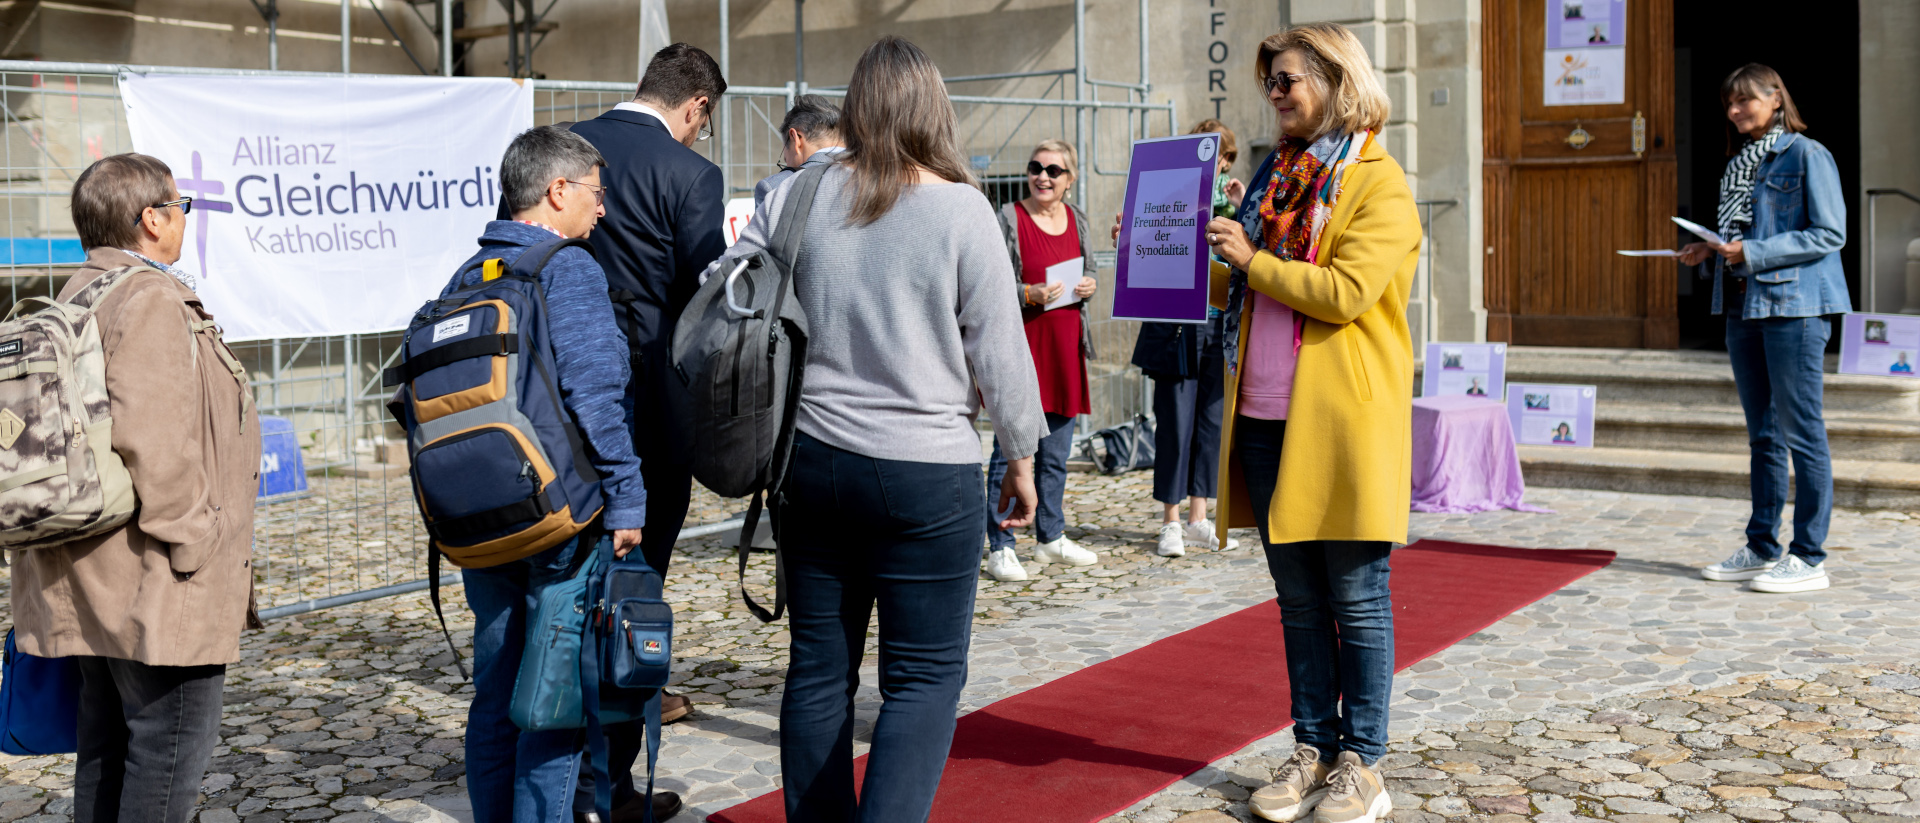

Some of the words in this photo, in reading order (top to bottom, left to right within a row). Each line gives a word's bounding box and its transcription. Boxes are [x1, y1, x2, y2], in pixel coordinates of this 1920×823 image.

[232, 136, 337, 166] Allianz
[235, 166, 503, 217] Gleichwürdi
[1144, 202, 1171, 214] Heute
[1173, 201, 1188, 213] für
[1134, 215, 1195, 228] Freund:innen
[245, 220, 397, 254] Katholisch
[1154, 230, 1171, 242] der
[1136, 243, 1189, 260] Synodalität
